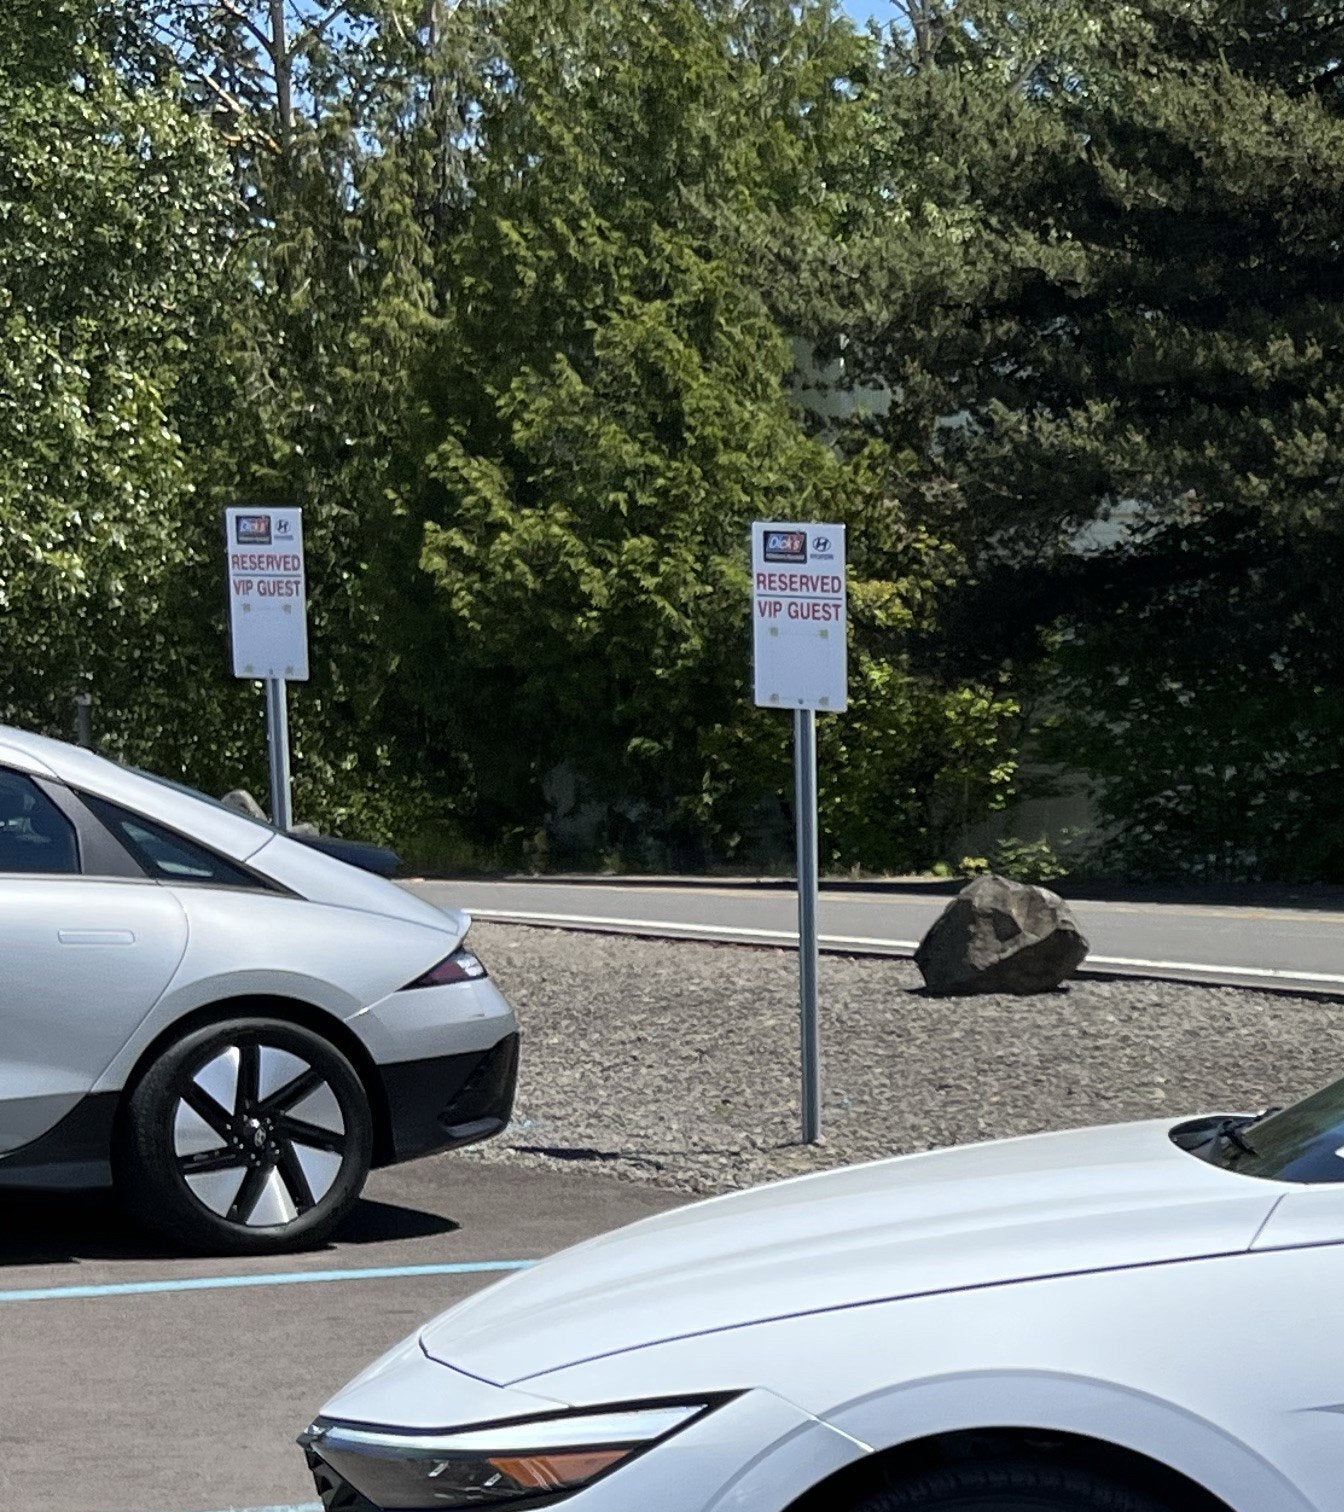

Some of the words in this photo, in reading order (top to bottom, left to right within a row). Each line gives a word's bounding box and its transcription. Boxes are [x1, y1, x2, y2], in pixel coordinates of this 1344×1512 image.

[231, 554, 301, 572] RESERVED
[232, 579, 254, 596] VIP
[257, 580, 301, 597] GUEST
[756, 572, 843, 594] RESERVED
[757, 601, 783, 618] VIP
[787, 602, 842, 621] GUEST
